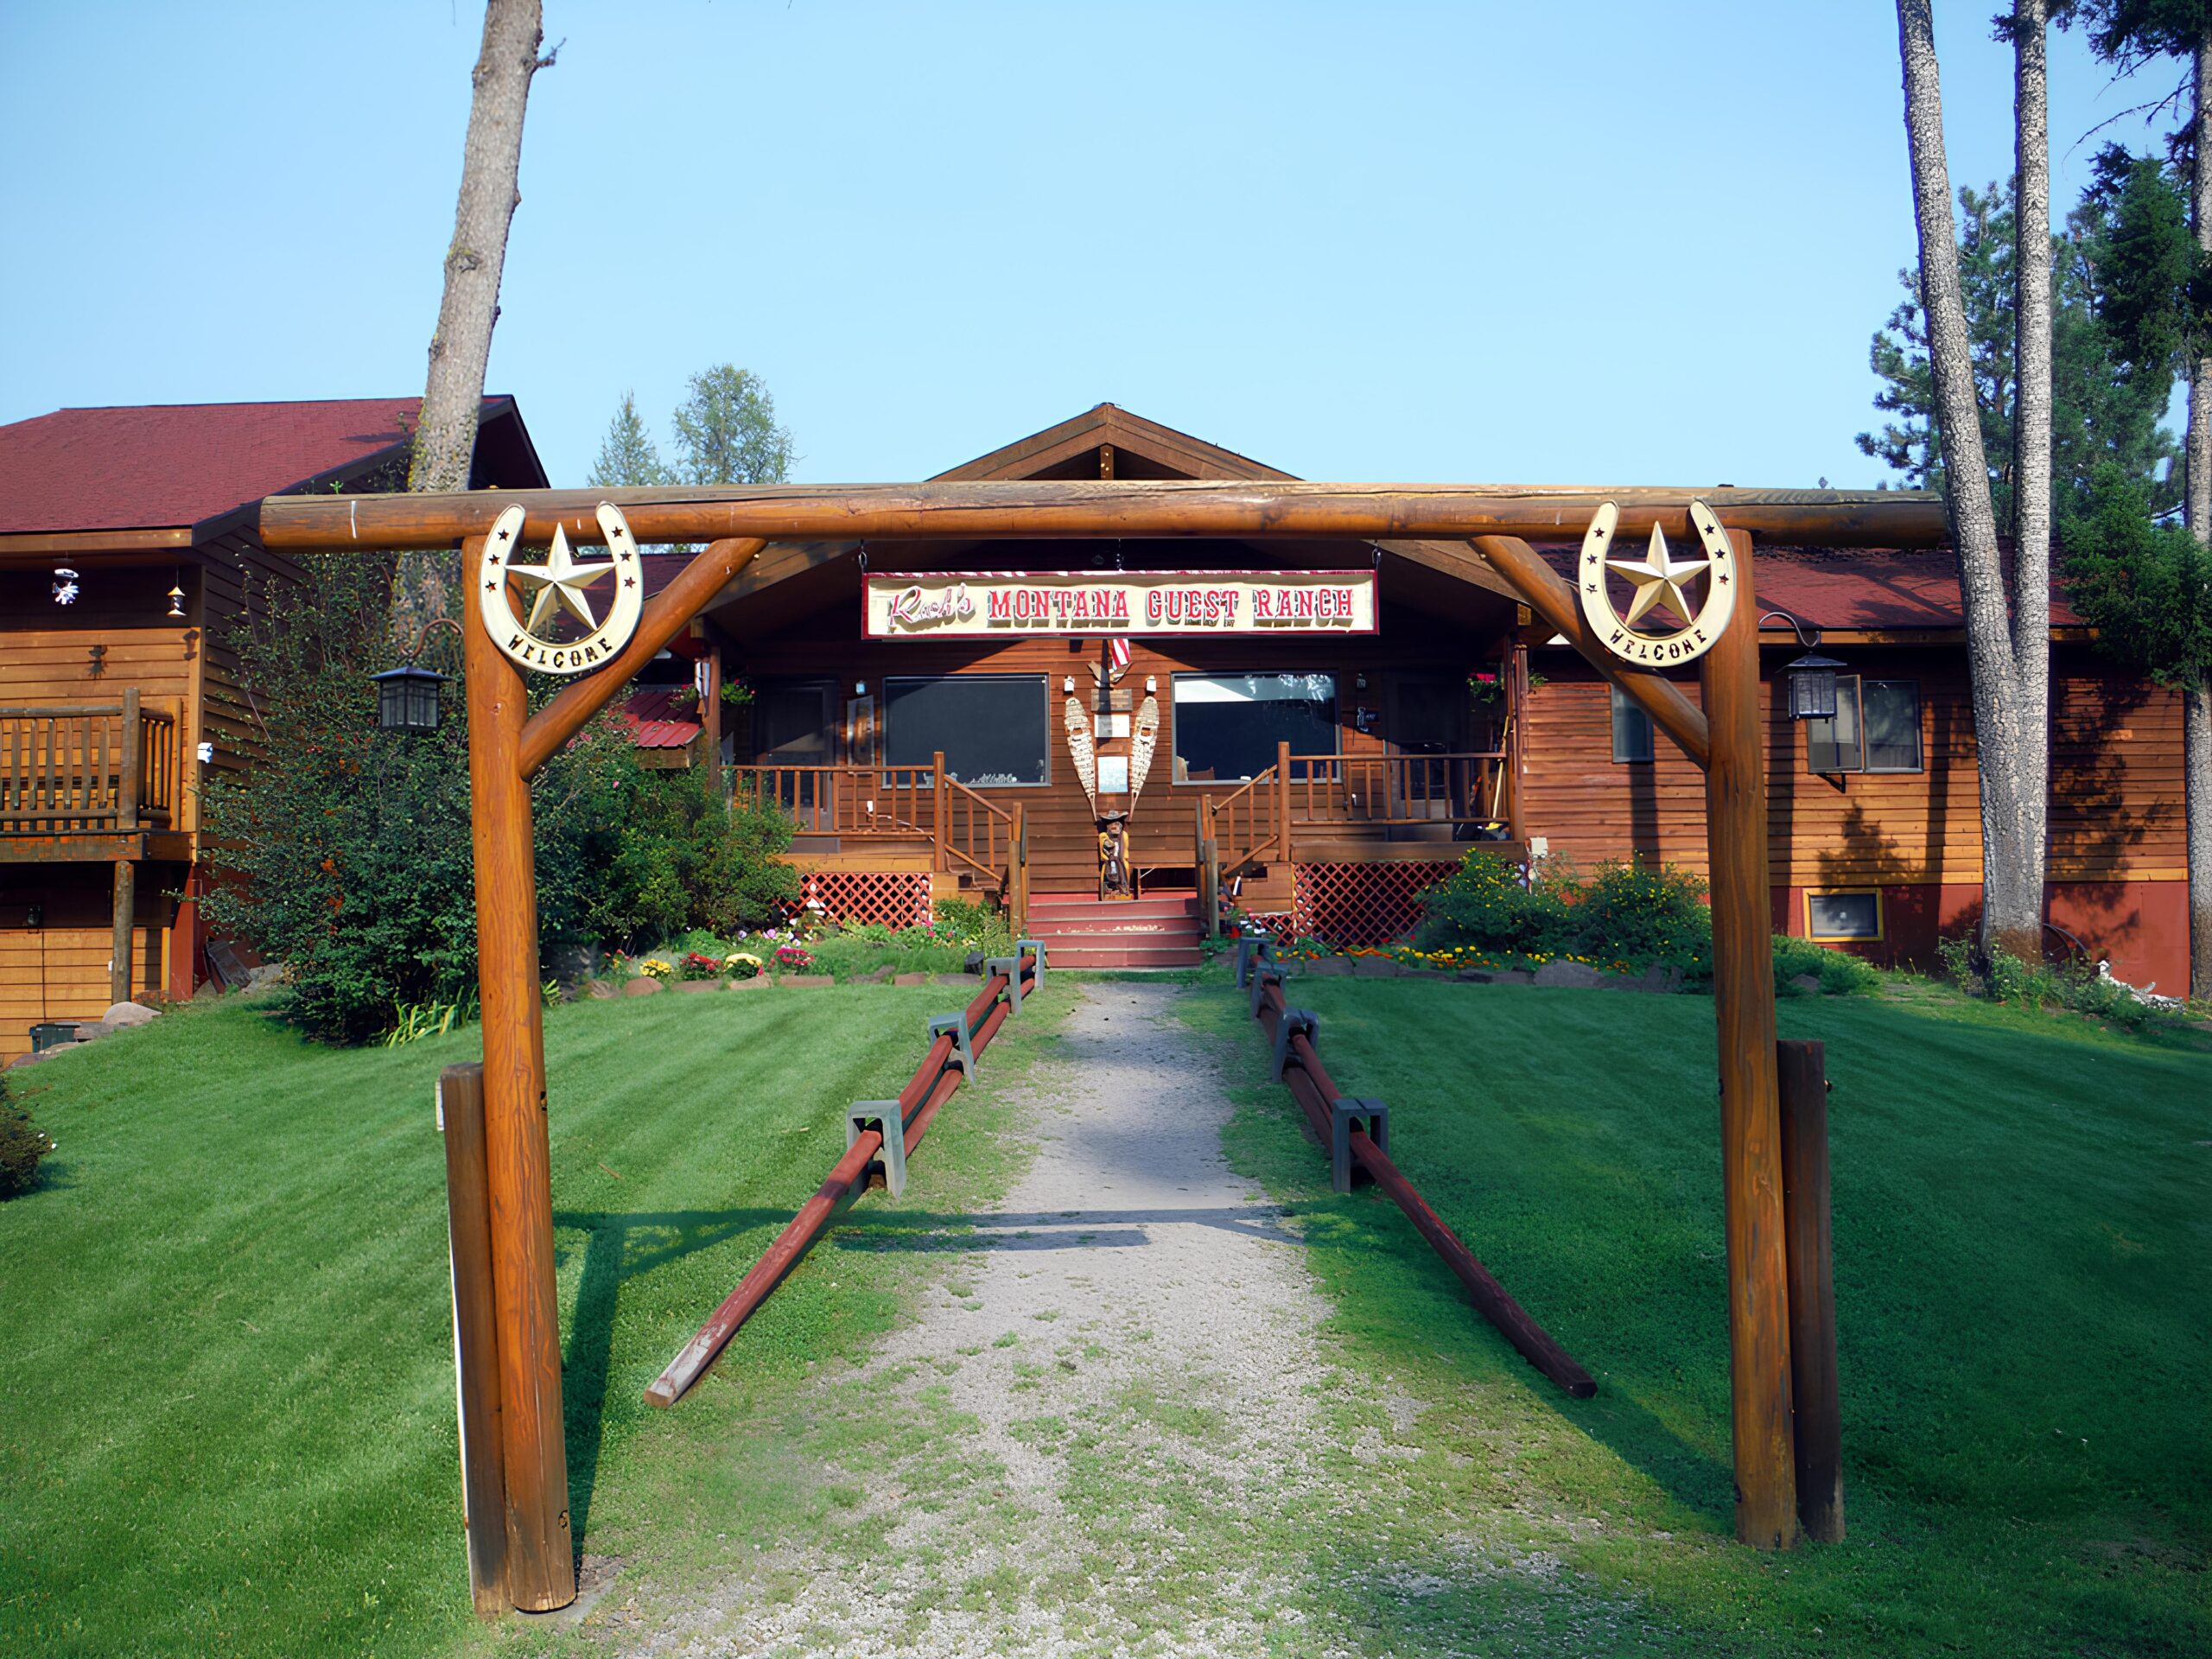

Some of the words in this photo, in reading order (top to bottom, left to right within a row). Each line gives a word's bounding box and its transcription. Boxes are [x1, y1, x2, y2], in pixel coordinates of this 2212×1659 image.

[987, 589, 1131, 620] MONTANA
[1147, 589, 1239, 620] GUEST
[1253, 588, 1355, 620] RANCH
[508, 634, 613, 668] WELCOME
[1611, 628, 1707, 660] WELCOME
